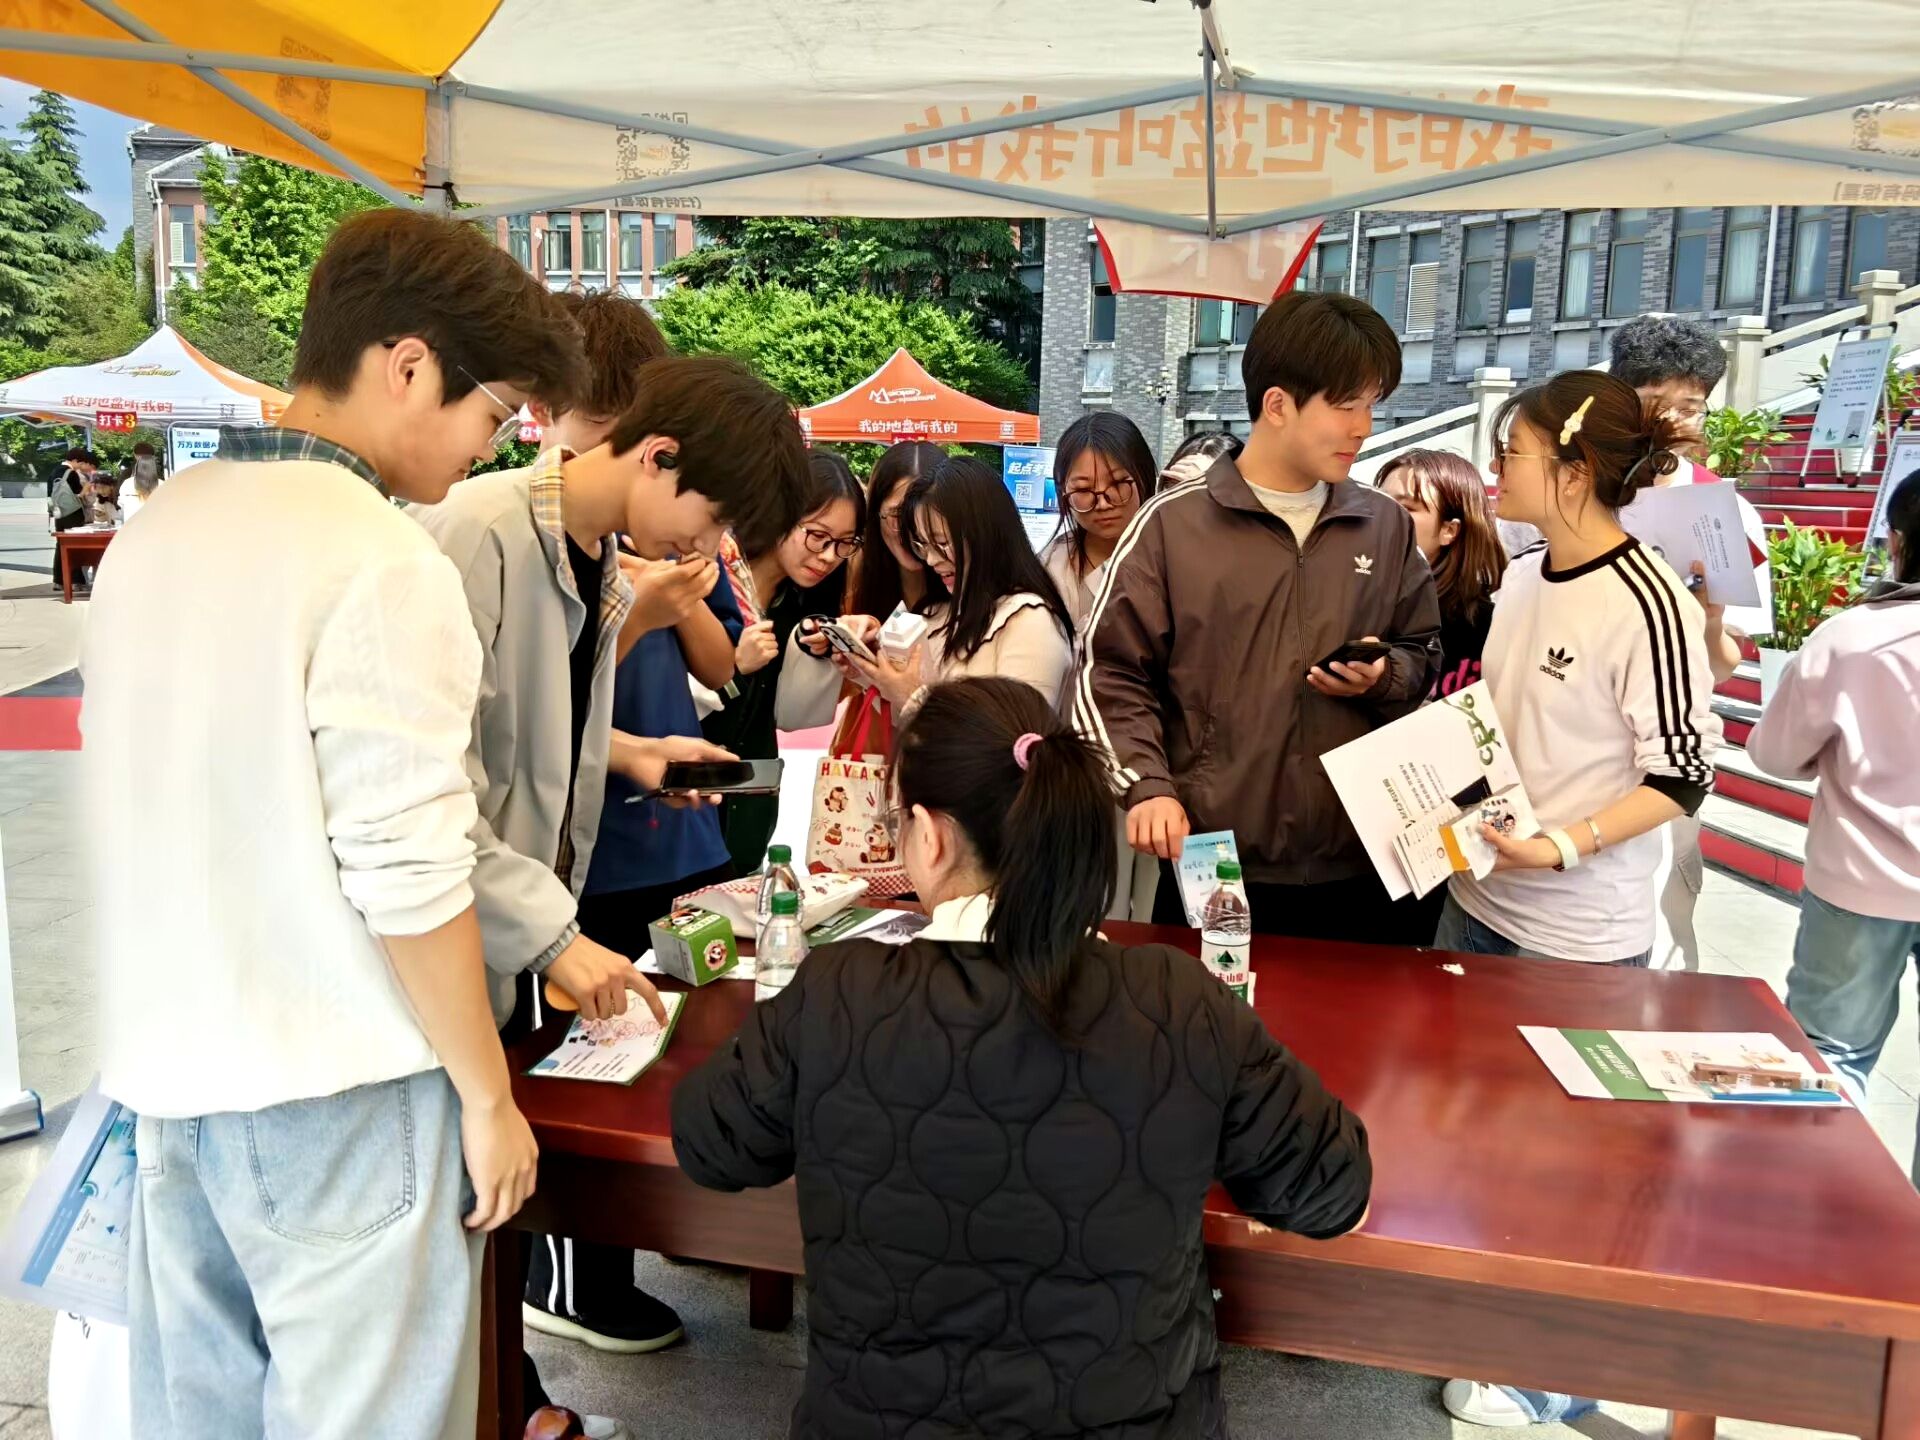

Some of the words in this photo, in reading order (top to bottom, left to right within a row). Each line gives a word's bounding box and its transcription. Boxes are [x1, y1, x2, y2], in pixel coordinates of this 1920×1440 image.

[63, 395, 173, 413] 我的地盘听我的
[859, 418, 958, 434] 我的地盘听我的
[1539, 664, 1566, 682] adidas
[1210, 970, 1244, 983] 夫山泉
